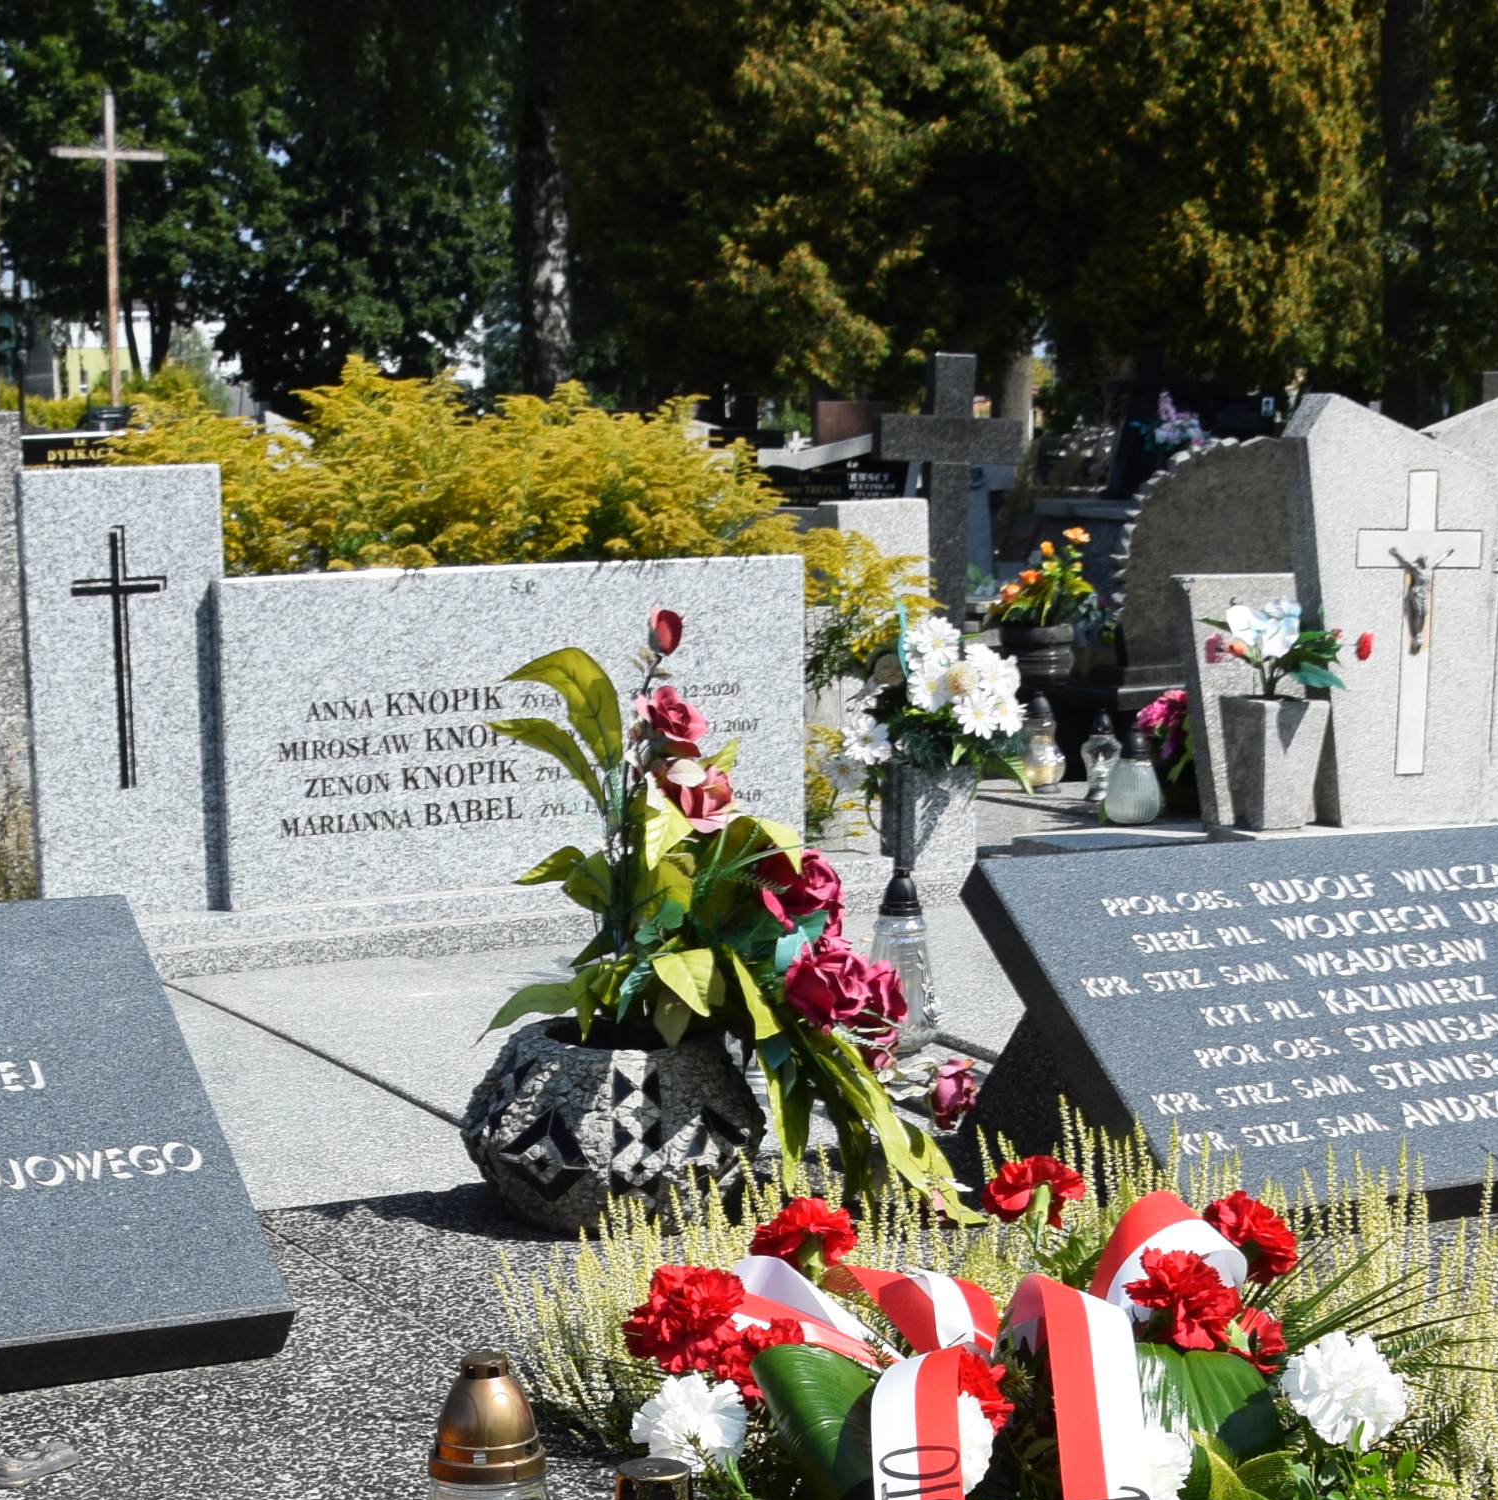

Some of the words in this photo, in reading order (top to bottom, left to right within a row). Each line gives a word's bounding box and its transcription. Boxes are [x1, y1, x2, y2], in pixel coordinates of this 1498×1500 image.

[305, 698, 374, 723] ANNA
[386, 686, 502, 717] KNOPIK
[278, 732, 414, 762] MIROSŁAW
[305, 772, 390, 798] ZENON
[401, 759, 519, 791] KNOPIK
[280, 809, 412, 839] MARIANNA
[424, 796, 522, 829] BĄBEL
[1249, 872, 1375, 906] RUDOLF
[1132, 924, 1216, 953] SIERŻ.
[1216, 926, 1266, 947] PIL.
[1270, 904, 1451, 941] WOJCIECH
[1081, 975, 1140, 998] KPR.
[1143, 967, 1216, 993] STRZ.
[1218, 962, 1290, 986] SAM.
[1293, 937, 1488, 977] WŁADYSŁAW
[1200, 1002, 1262, 1028] KPT.
[1265, 999, 1314, 1021] PIL.
[1318, 974, 1497, 1016] KAZIMIERZ
[1151, 1091, 1212, 1116] KPR.
[1215, 1081, 1290, 1108] STRZ.
[1291, 1074, 1365, 1099] SAM.
[1240, 1120, 1314, 1148] STRZ.
[1317, 1112, 1390, 1138] SAM.
